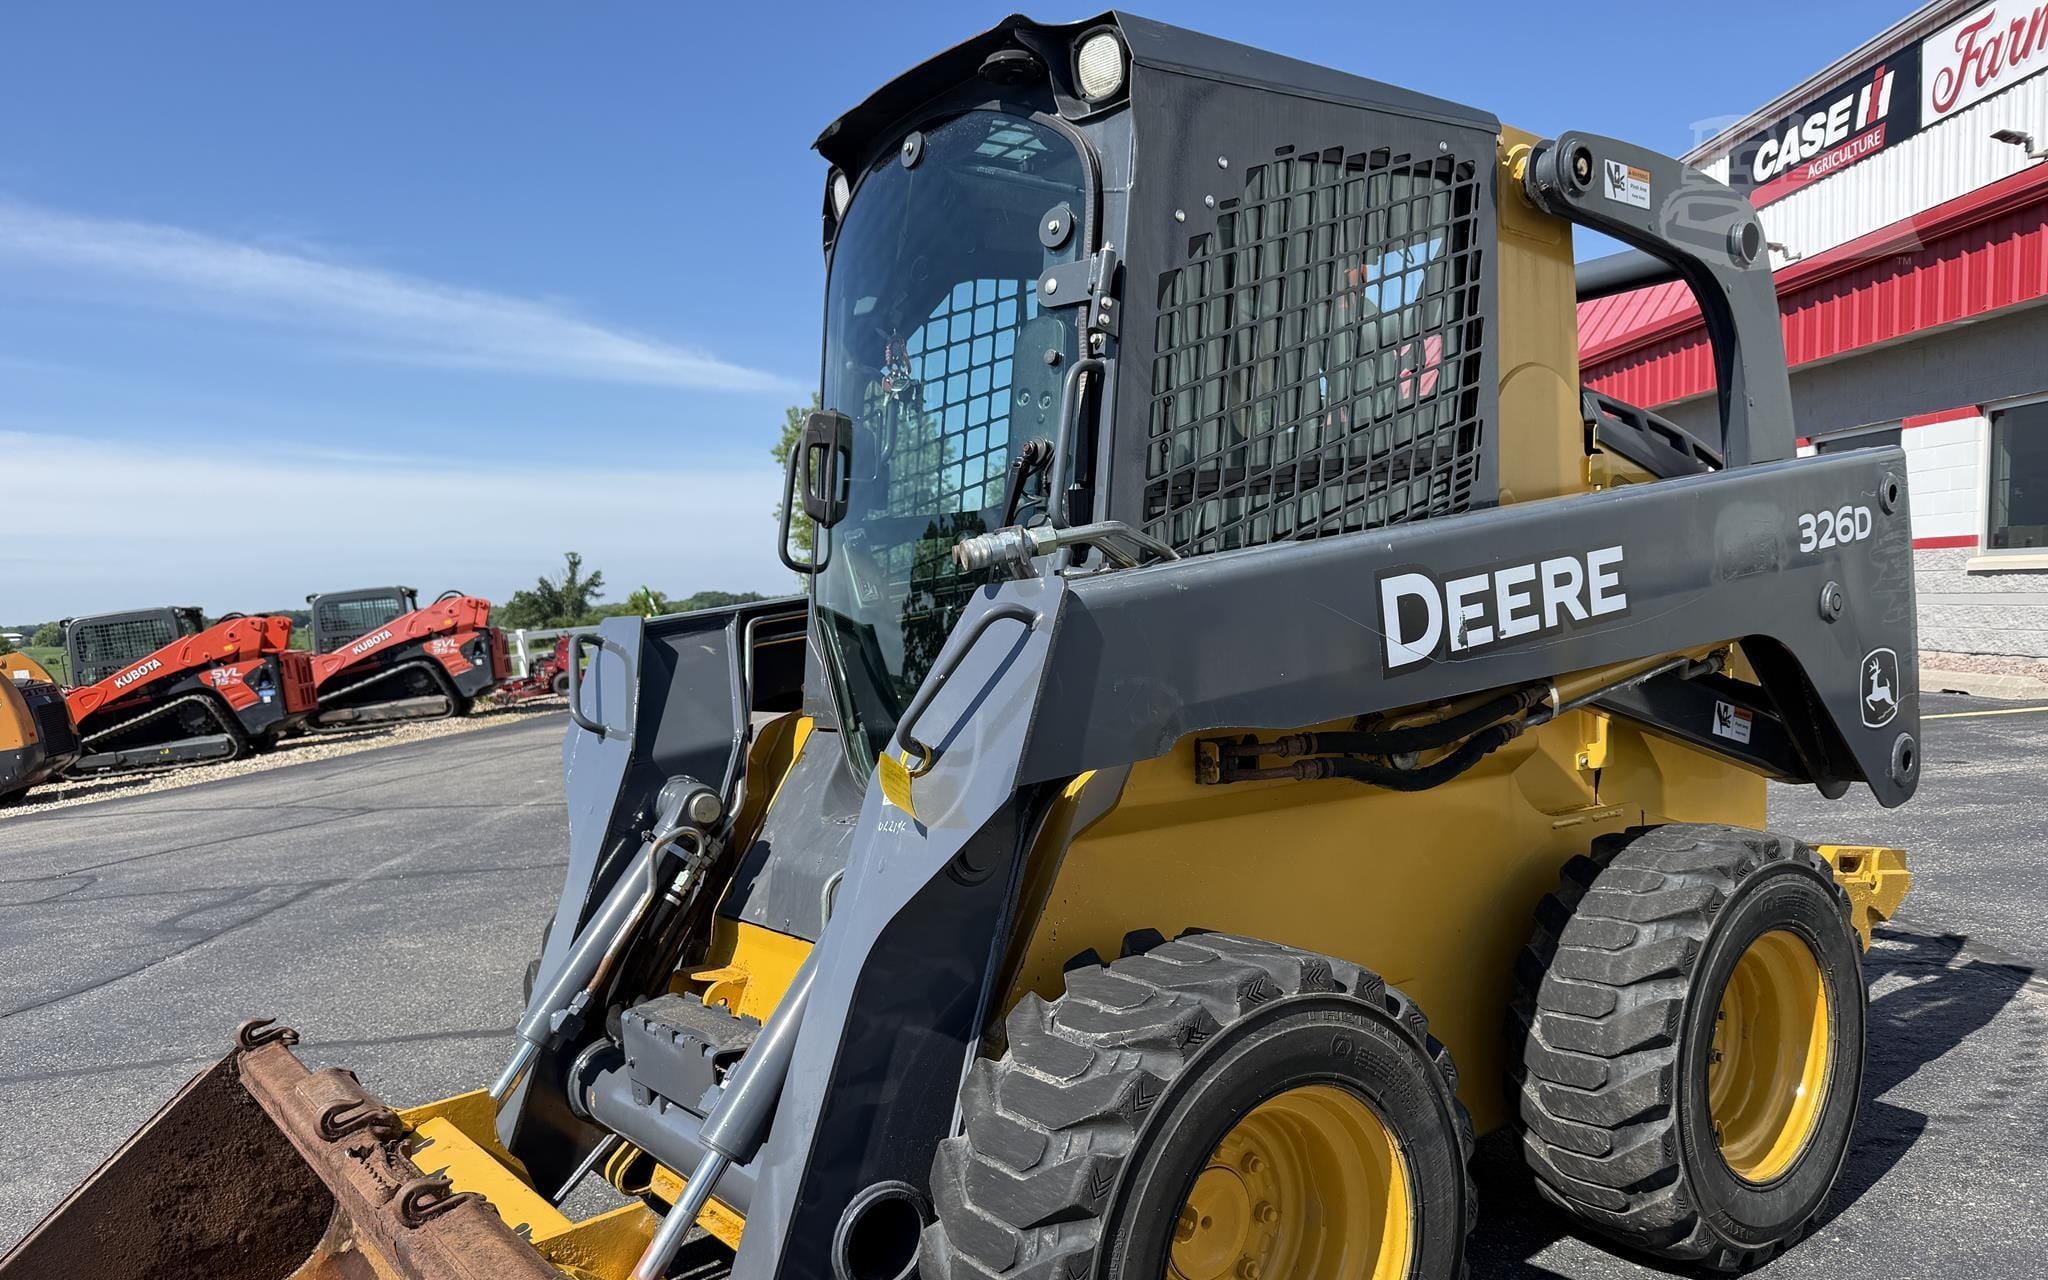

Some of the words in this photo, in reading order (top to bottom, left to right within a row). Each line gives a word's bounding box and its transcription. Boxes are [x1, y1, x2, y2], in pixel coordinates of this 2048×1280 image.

[1752, 93, 1854, 183] CASE
[1807, 129, 1881, 180] AGRICULTURE
[1798, 505, 1872, 553] 326D
[1380, 545, 1627, 668] DEERE
[351, 630, 393, 655] KUBOTA
[113, 658, 163, 689] KUBOTA
[211, 667, 243, 679] SVL
